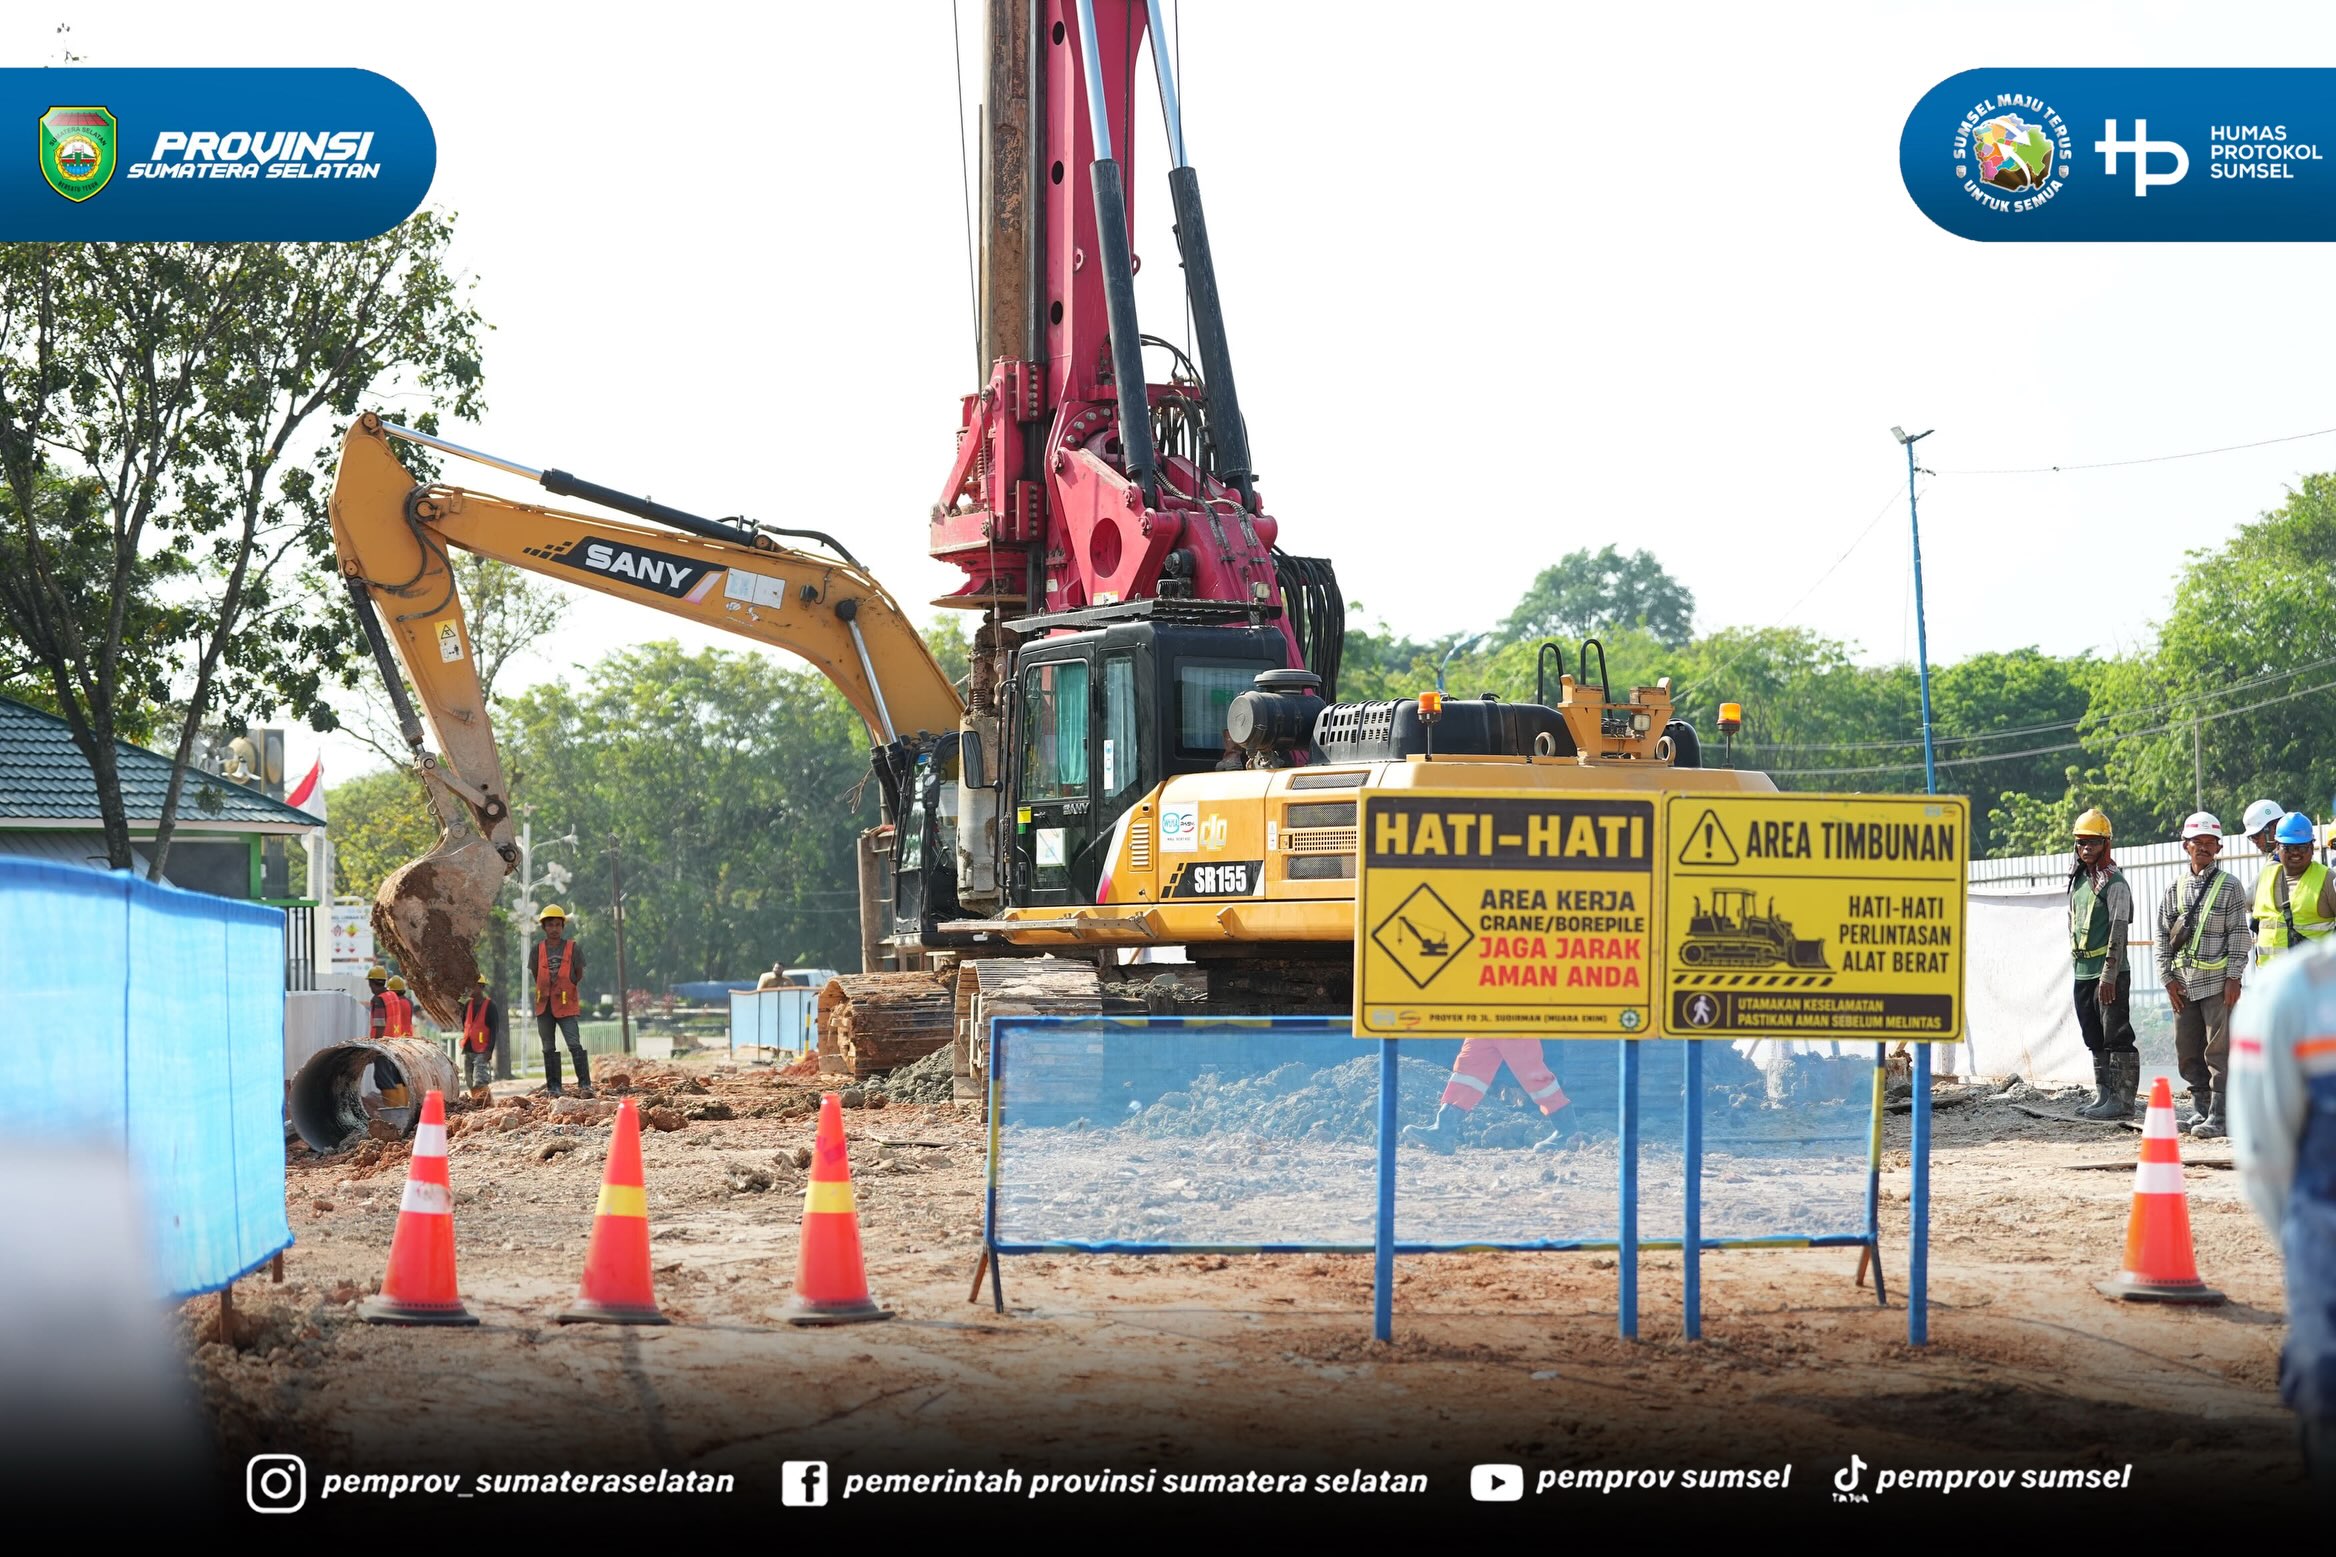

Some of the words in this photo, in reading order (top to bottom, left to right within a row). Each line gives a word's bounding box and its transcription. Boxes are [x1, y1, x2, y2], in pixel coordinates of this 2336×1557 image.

[584, 544, 692, 590] SANY
[1374, 812, 1644, 858] HATI-HATI
[1746, 821, 1812, 859] AREA
[1821, 822, 1954, 862] TIMBUNAN
[1194, 865, 1247, 893] SR155
[1480, 889, 1547, 911] AREA
[1557, 890, 1635, 912] KERJA
[1848, 896, 1944, 919] HATI-HATI
[1480, 915, 1644, 933] CRANE/BOREPILE
[1839, 924, 1951, 946] PERLINTASAN
[1479, 937, 1547, 959] JAGA
[1555, 938, 1641, 960] JARAK
[1842, 951, 1886, 973] ALAT
[1892, 952, 1950, 974] BERAT
[1479, 965, 1557, 987] AMAN
[1567, 966, 1640, 988] ANDA
[1738, 998, 1800, 1011] UTAMAKAN
[1803, 999, 1884, 1013] KESELAMATAN
[1737, 1013, 1794, 1027] PASTIKAN
[1795, 1014, 1830, 1028] AMAN
[1831, 1015, 1884, 1029] SEBELUM
[1885, 1016, 1942, 1030] MELINTAS
